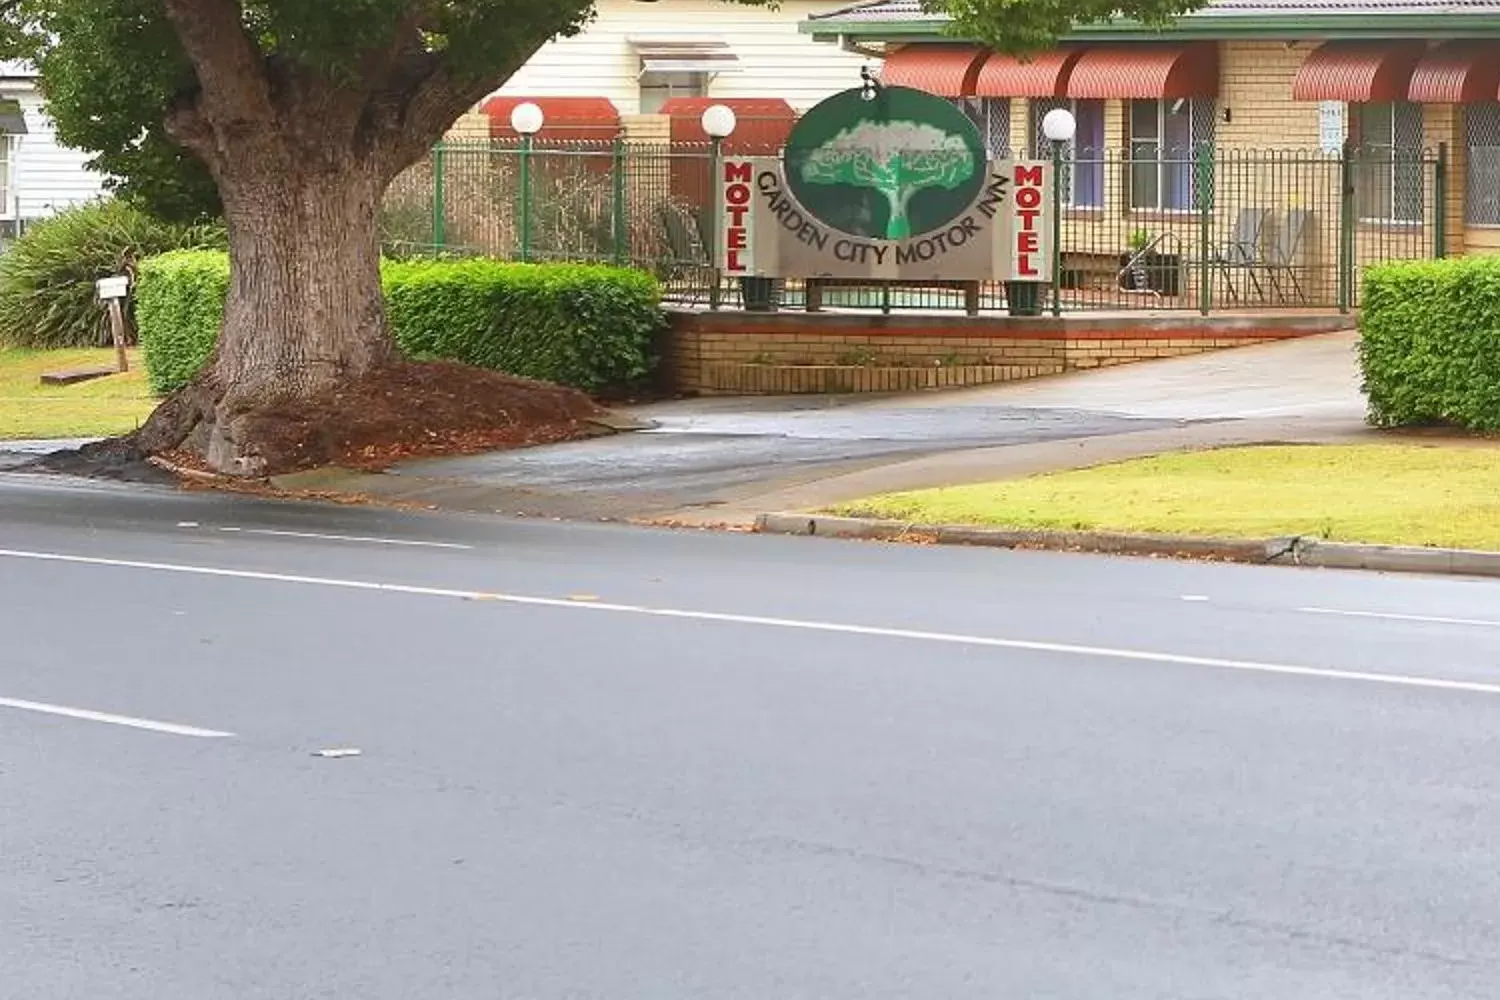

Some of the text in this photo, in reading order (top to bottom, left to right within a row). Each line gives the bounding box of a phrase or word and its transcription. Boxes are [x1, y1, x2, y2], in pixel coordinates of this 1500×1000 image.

[725, 162, 752, 271] MOTEL
[757, 171, 1011, 265] GARDEN CITY MOTOR INN
[1014, 164, 1043, 276] MOTEL
